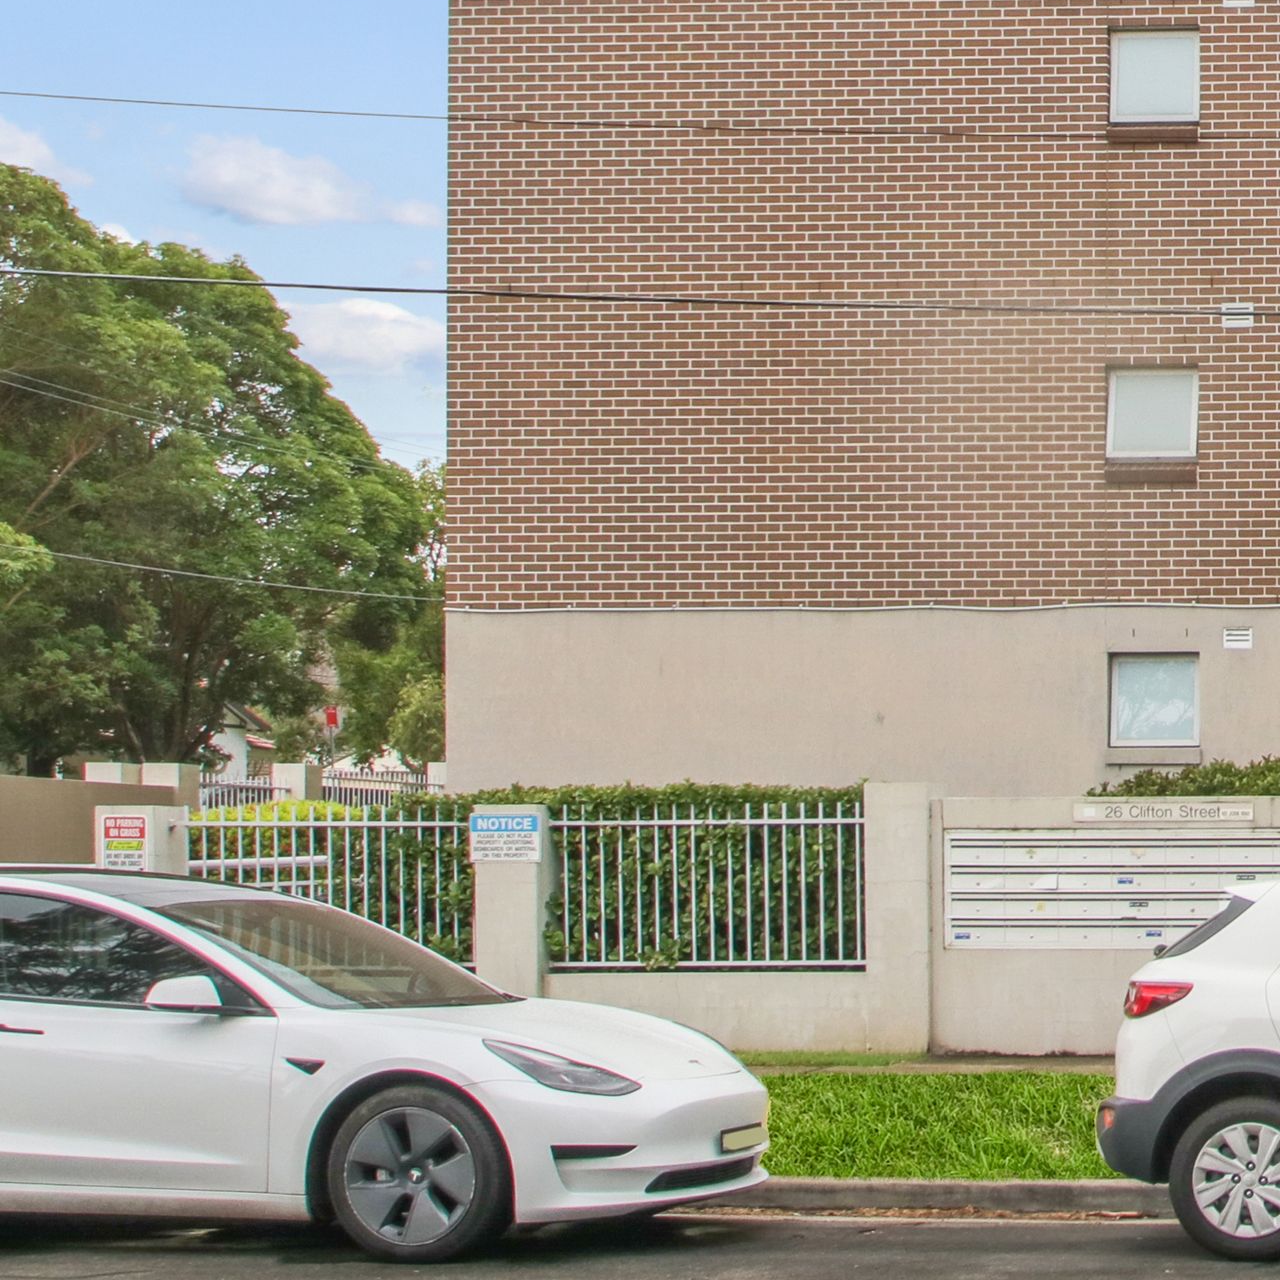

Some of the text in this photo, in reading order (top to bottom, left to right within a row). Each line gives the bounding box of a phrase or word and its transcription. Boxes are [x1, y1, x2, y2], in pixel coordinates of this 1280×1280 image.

[1104, 805, 1221, 818] 26 Clifton Street
[105, 819, 144, 827] NO PARKING
[477, 818, 533, 830] NOTICE
[120, 828, 141, 837] GRASS
